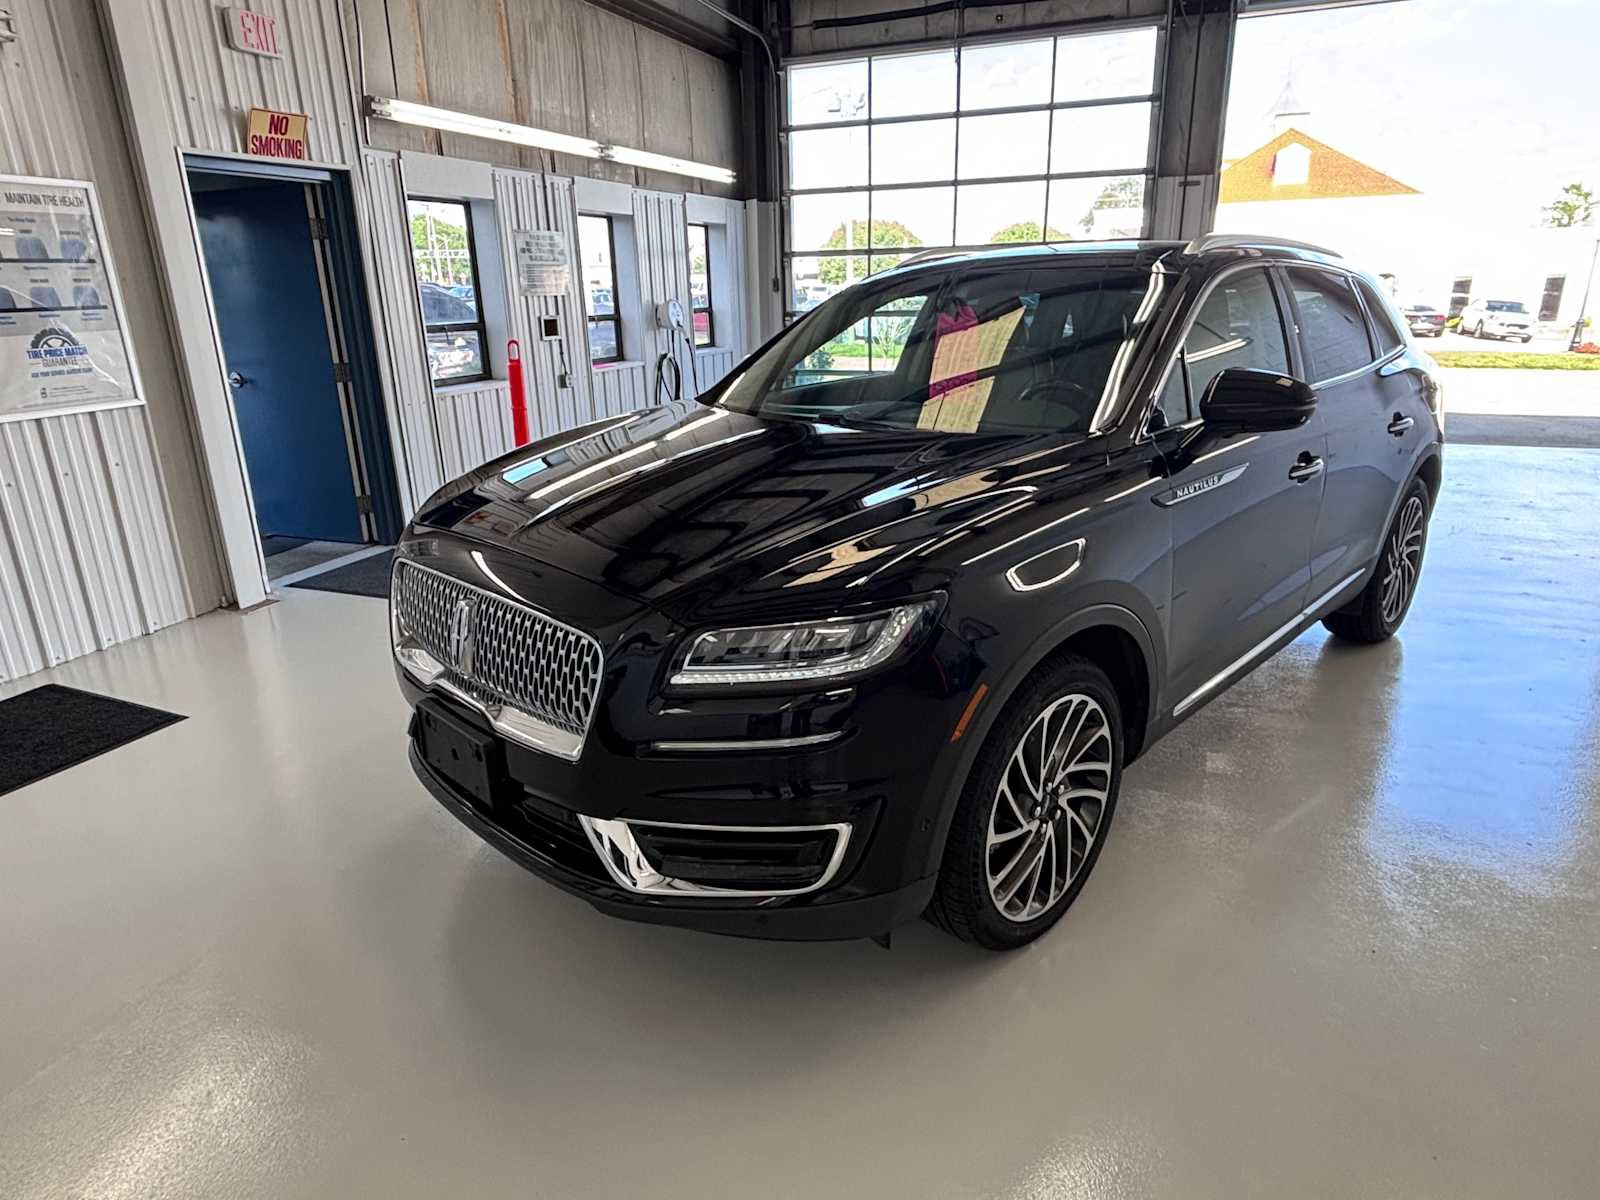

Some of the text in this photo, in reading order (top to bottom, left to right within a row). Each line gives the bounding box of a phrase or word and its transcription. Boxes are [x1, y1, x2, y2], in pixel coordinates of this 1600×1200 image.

[240, 9, 278, 54] EXIT
[268, 114, 289, 136] NO
[251, 135, 302, 160] SMOKING
[27, 349, 42, 360] TIRE
[44, 347, 64, 358] PRICE
[1176, 475, 1219, 499] NAUTILUS
